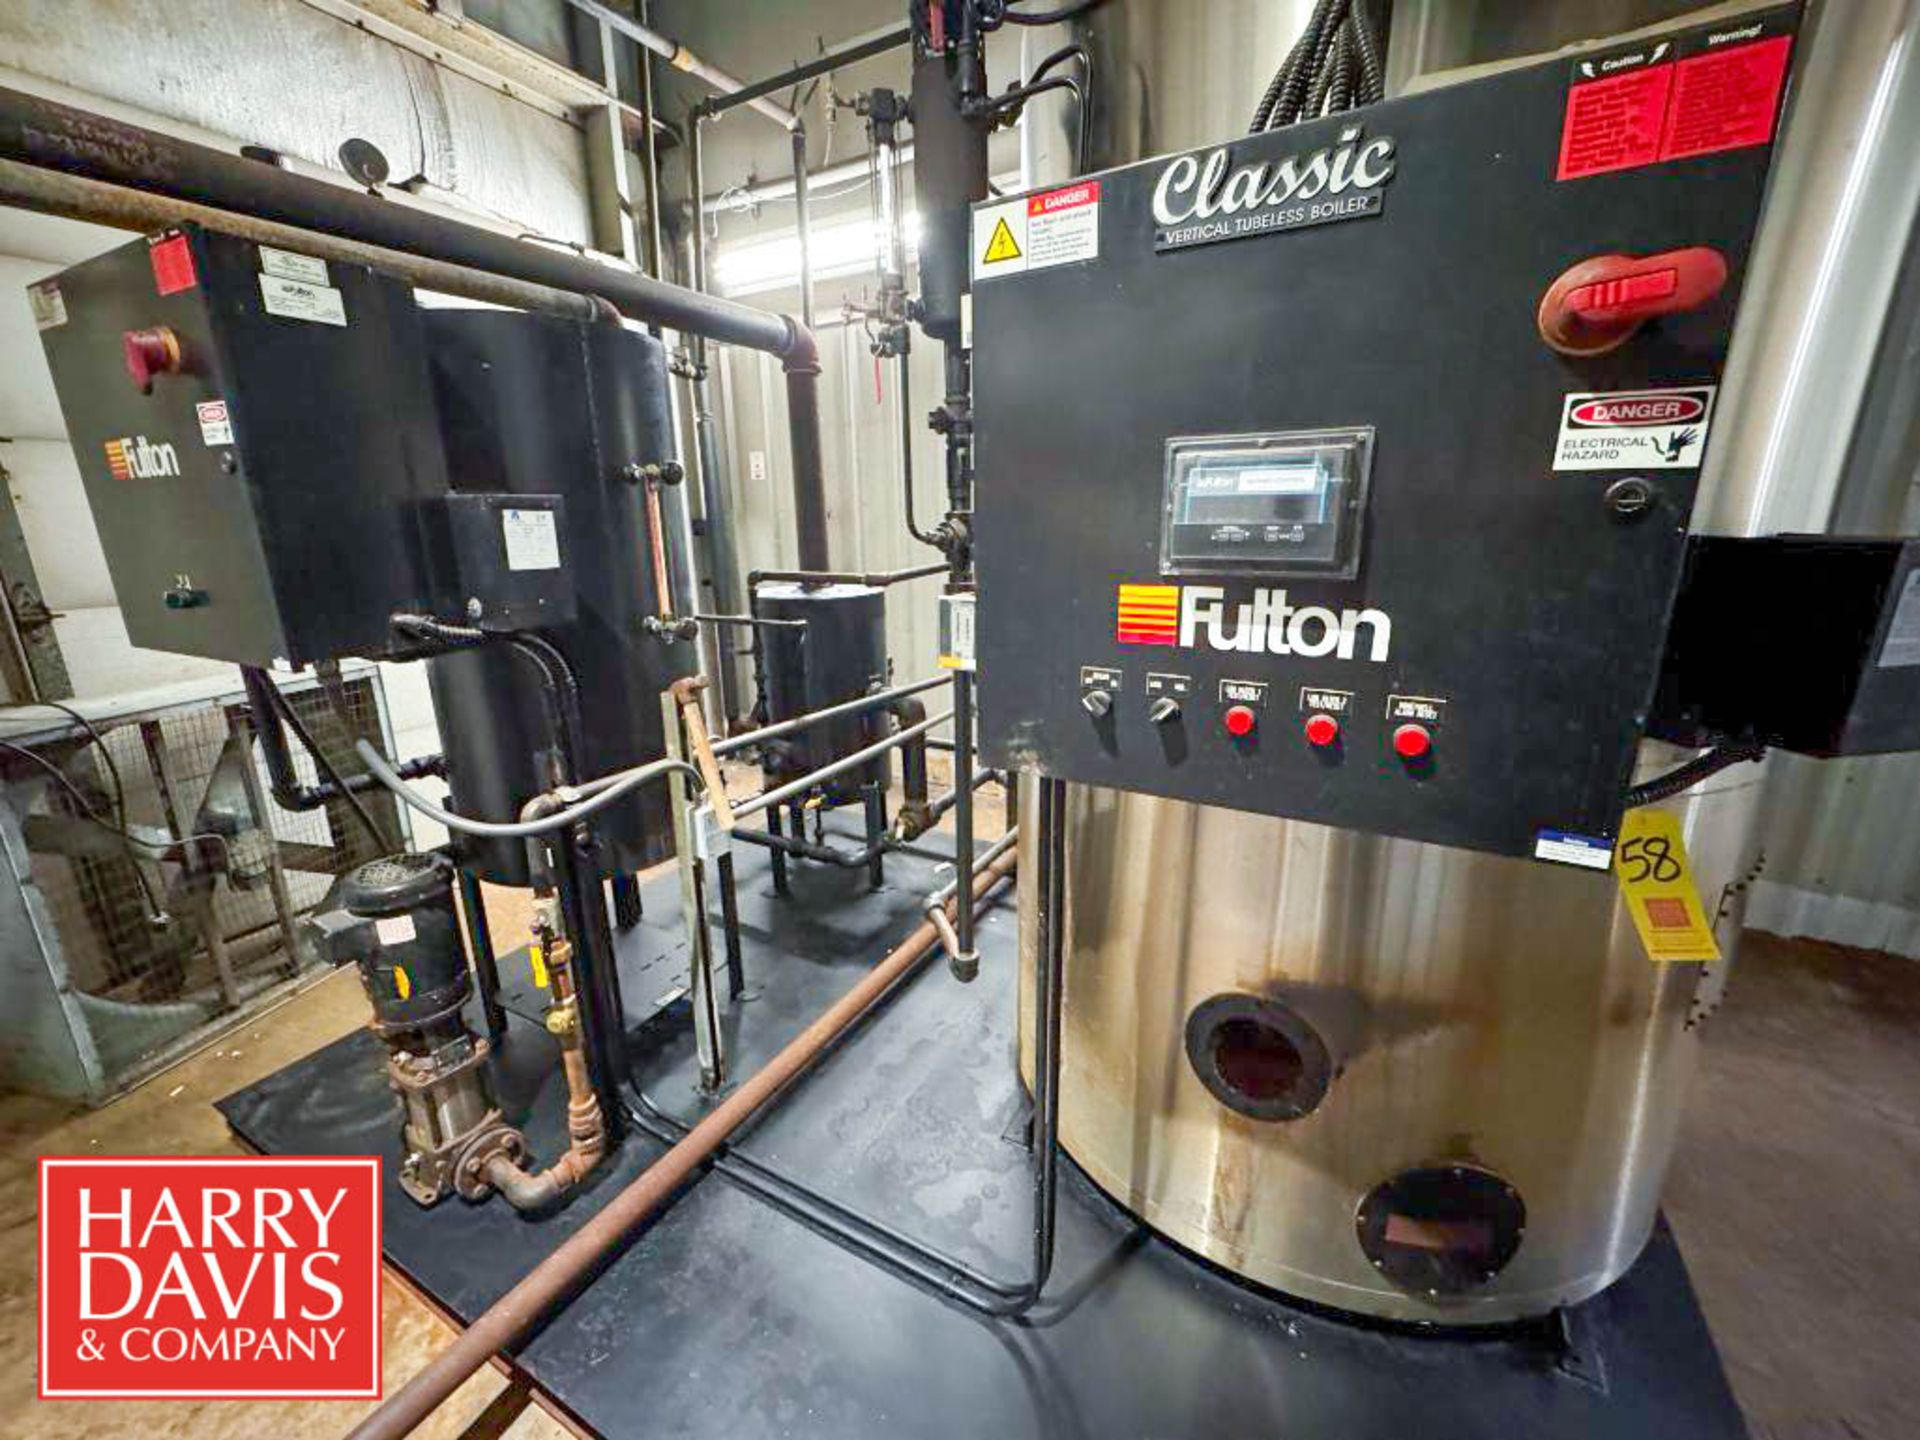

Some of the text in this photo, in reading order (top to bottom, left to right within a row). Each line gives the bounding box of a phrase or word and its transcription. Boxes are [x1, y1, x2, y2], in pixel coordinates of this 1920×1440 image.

[1602, 53, 1644, 71] Caution
[1153, 127, 1396, 227] Classic
[1045, 188, 1089, 209] DANGER
[1165, 197, 1369, 246] VERTICAL TUBELESS BOILER
[1592, 402, 1681, 420] DANGER
[119, 435, 181, 480] Fulton
[1561, 450, 1620, 461] HAZARD
[1563, 436, 1649, 449] ELECTRICAL
[1179, 585, 1392, 662] Fulton
[1620, 836, 1681, 883] 58
